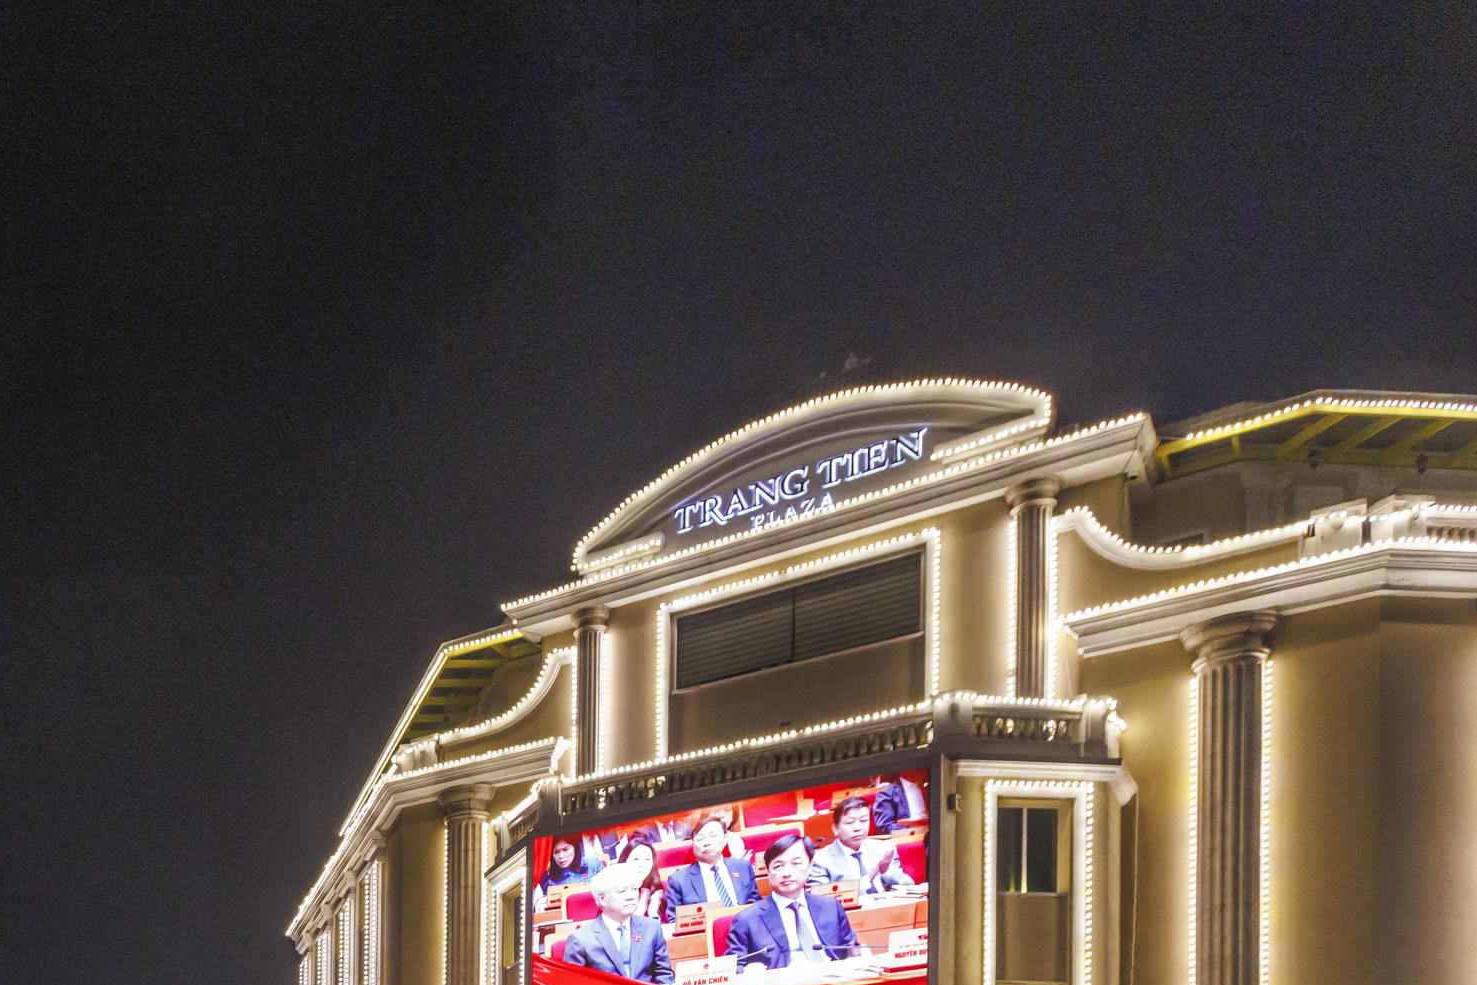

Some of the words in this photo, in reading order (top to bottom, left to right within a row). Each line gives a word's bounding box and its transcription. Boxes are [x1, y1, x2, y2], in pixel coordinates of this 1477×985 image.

[674, 465, 810, 534] TRANG
[816, 426, 928, 489] TIEN
[751, 492, 835, 530] PLAZA
